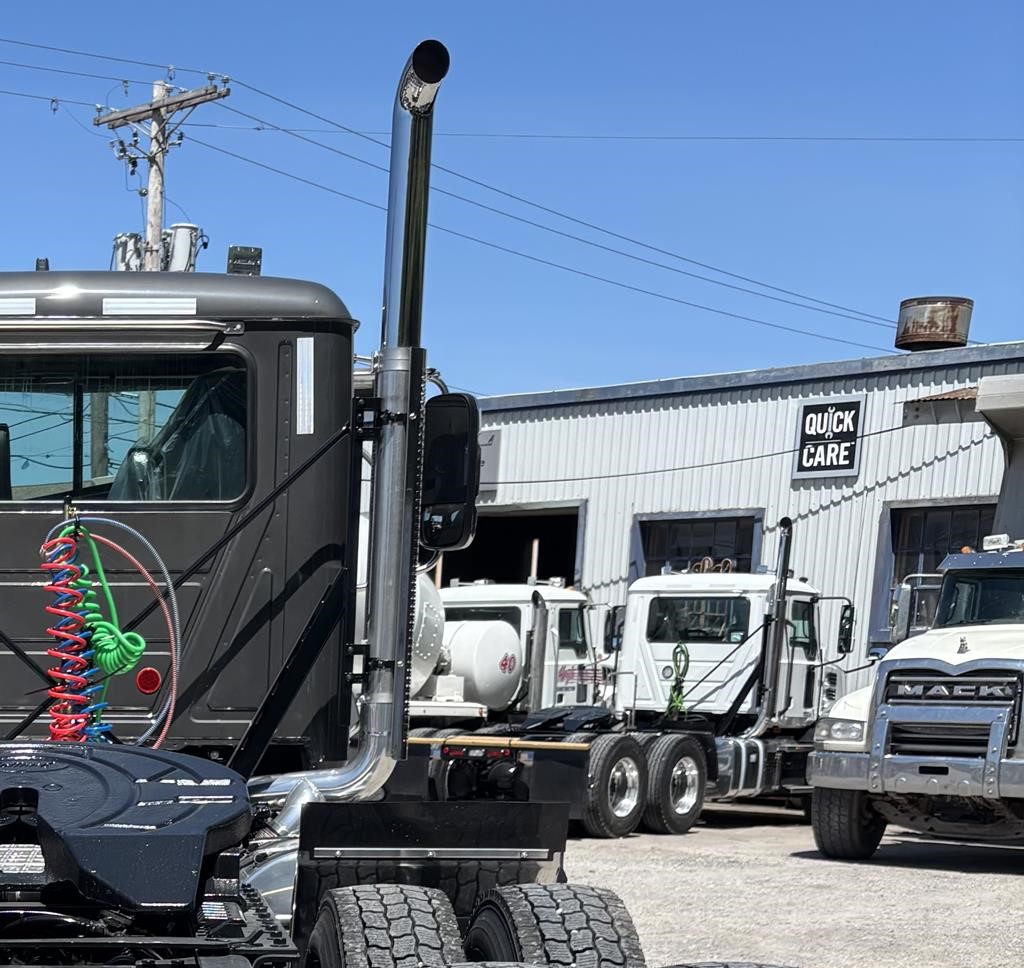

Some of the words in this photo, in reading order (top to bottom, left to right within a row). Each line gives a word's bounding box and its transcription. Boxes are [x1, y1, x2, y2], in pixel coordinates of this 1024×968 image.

[805, 406, 855, 439] QUICK
[499, 652, 516, 674] 40
[897, 684, 1007, 697] MACK
